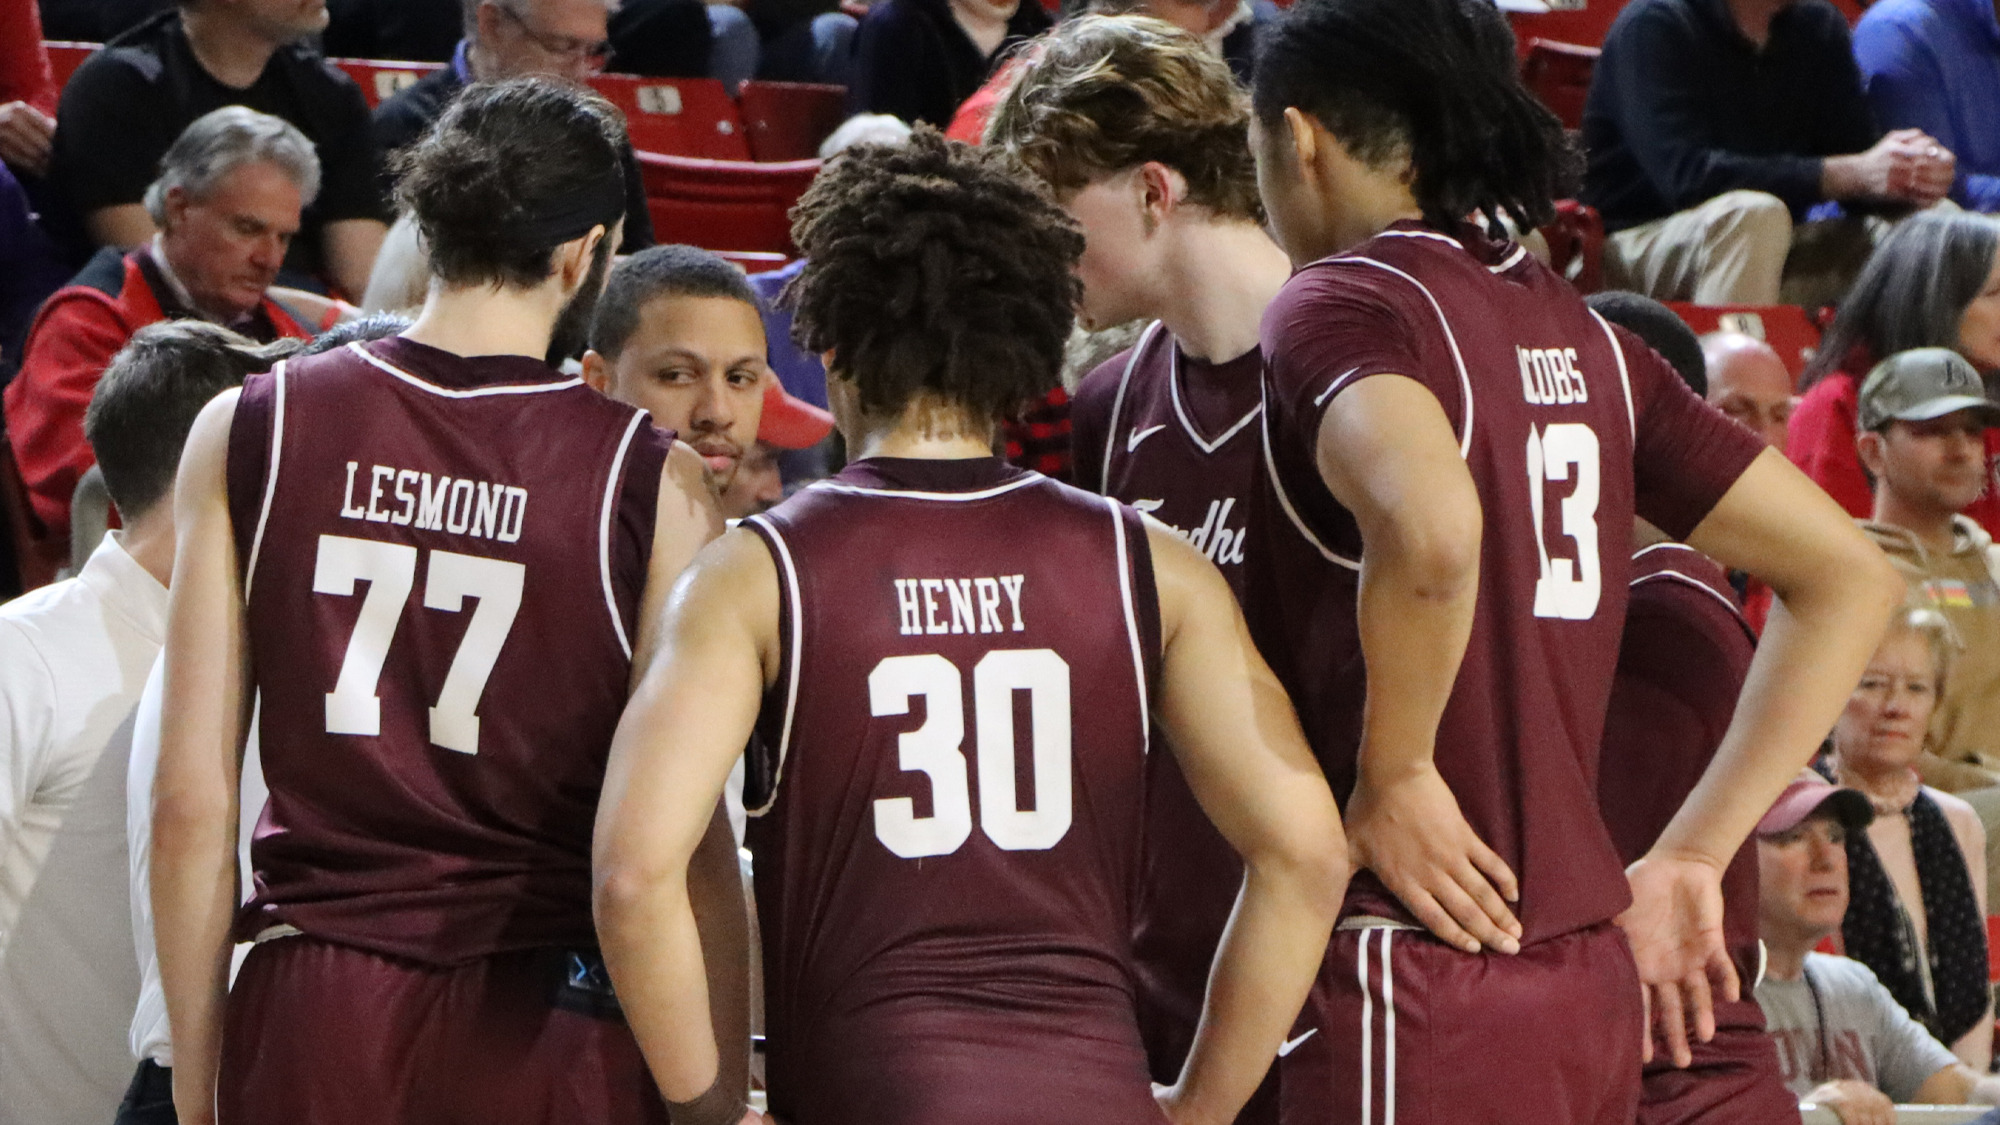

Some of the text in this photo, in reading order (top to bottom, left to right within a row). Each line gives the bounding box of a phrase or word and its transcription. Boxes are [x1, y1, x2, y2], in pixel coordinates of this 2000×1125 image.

[1516, 344, 1588, 405] COBS
[340, 461, 528, 543] LESMOND
[1526, 421, 1602, 620] 13
[313, 534, 526, 755] 77
[894, 574, 1025, 635] HENRY
[868, 648, 1073, 859] 30
